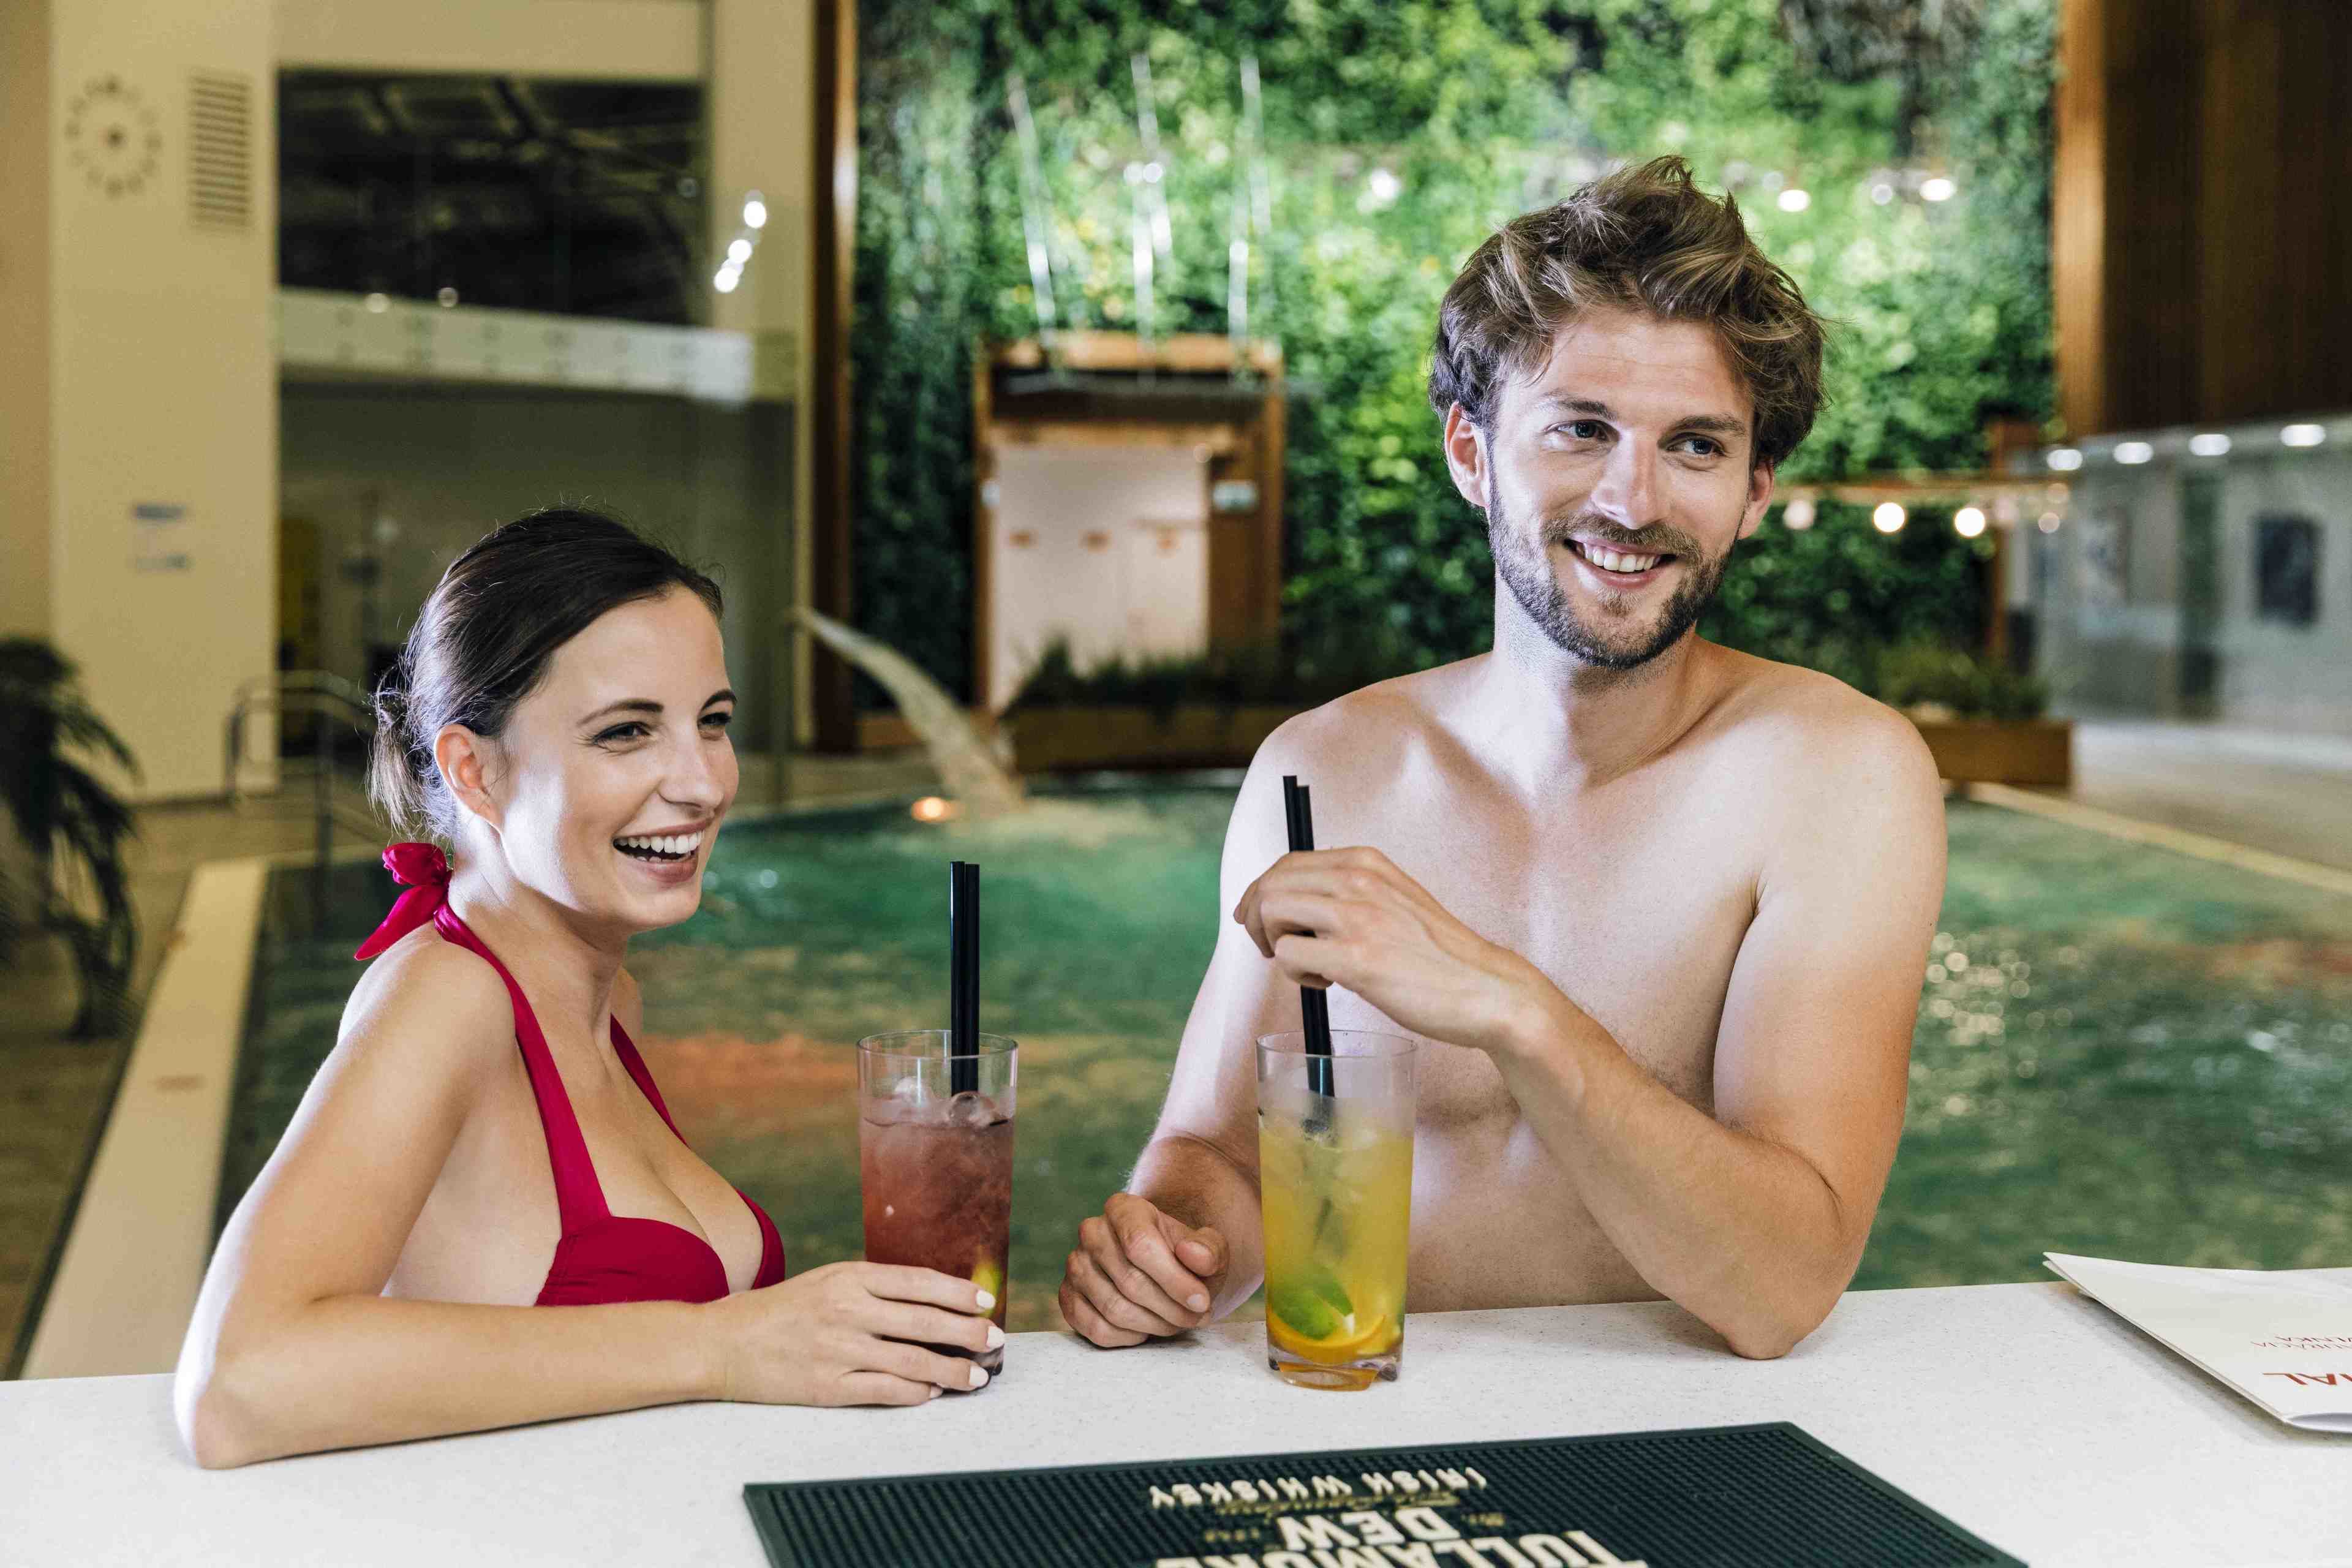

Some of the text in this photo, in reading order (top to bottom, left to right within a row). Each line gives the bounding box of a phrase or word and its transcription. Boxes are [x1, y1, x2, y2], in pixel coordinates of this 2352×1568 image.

[1149, 1474, 1352, 1509] WHISKEY
[1361, 1466, 1487, 1494] IRISH
[1276, 1507, 1461, 1551] DEW
[1155, 1530, 1649, 1568] TULLAM
